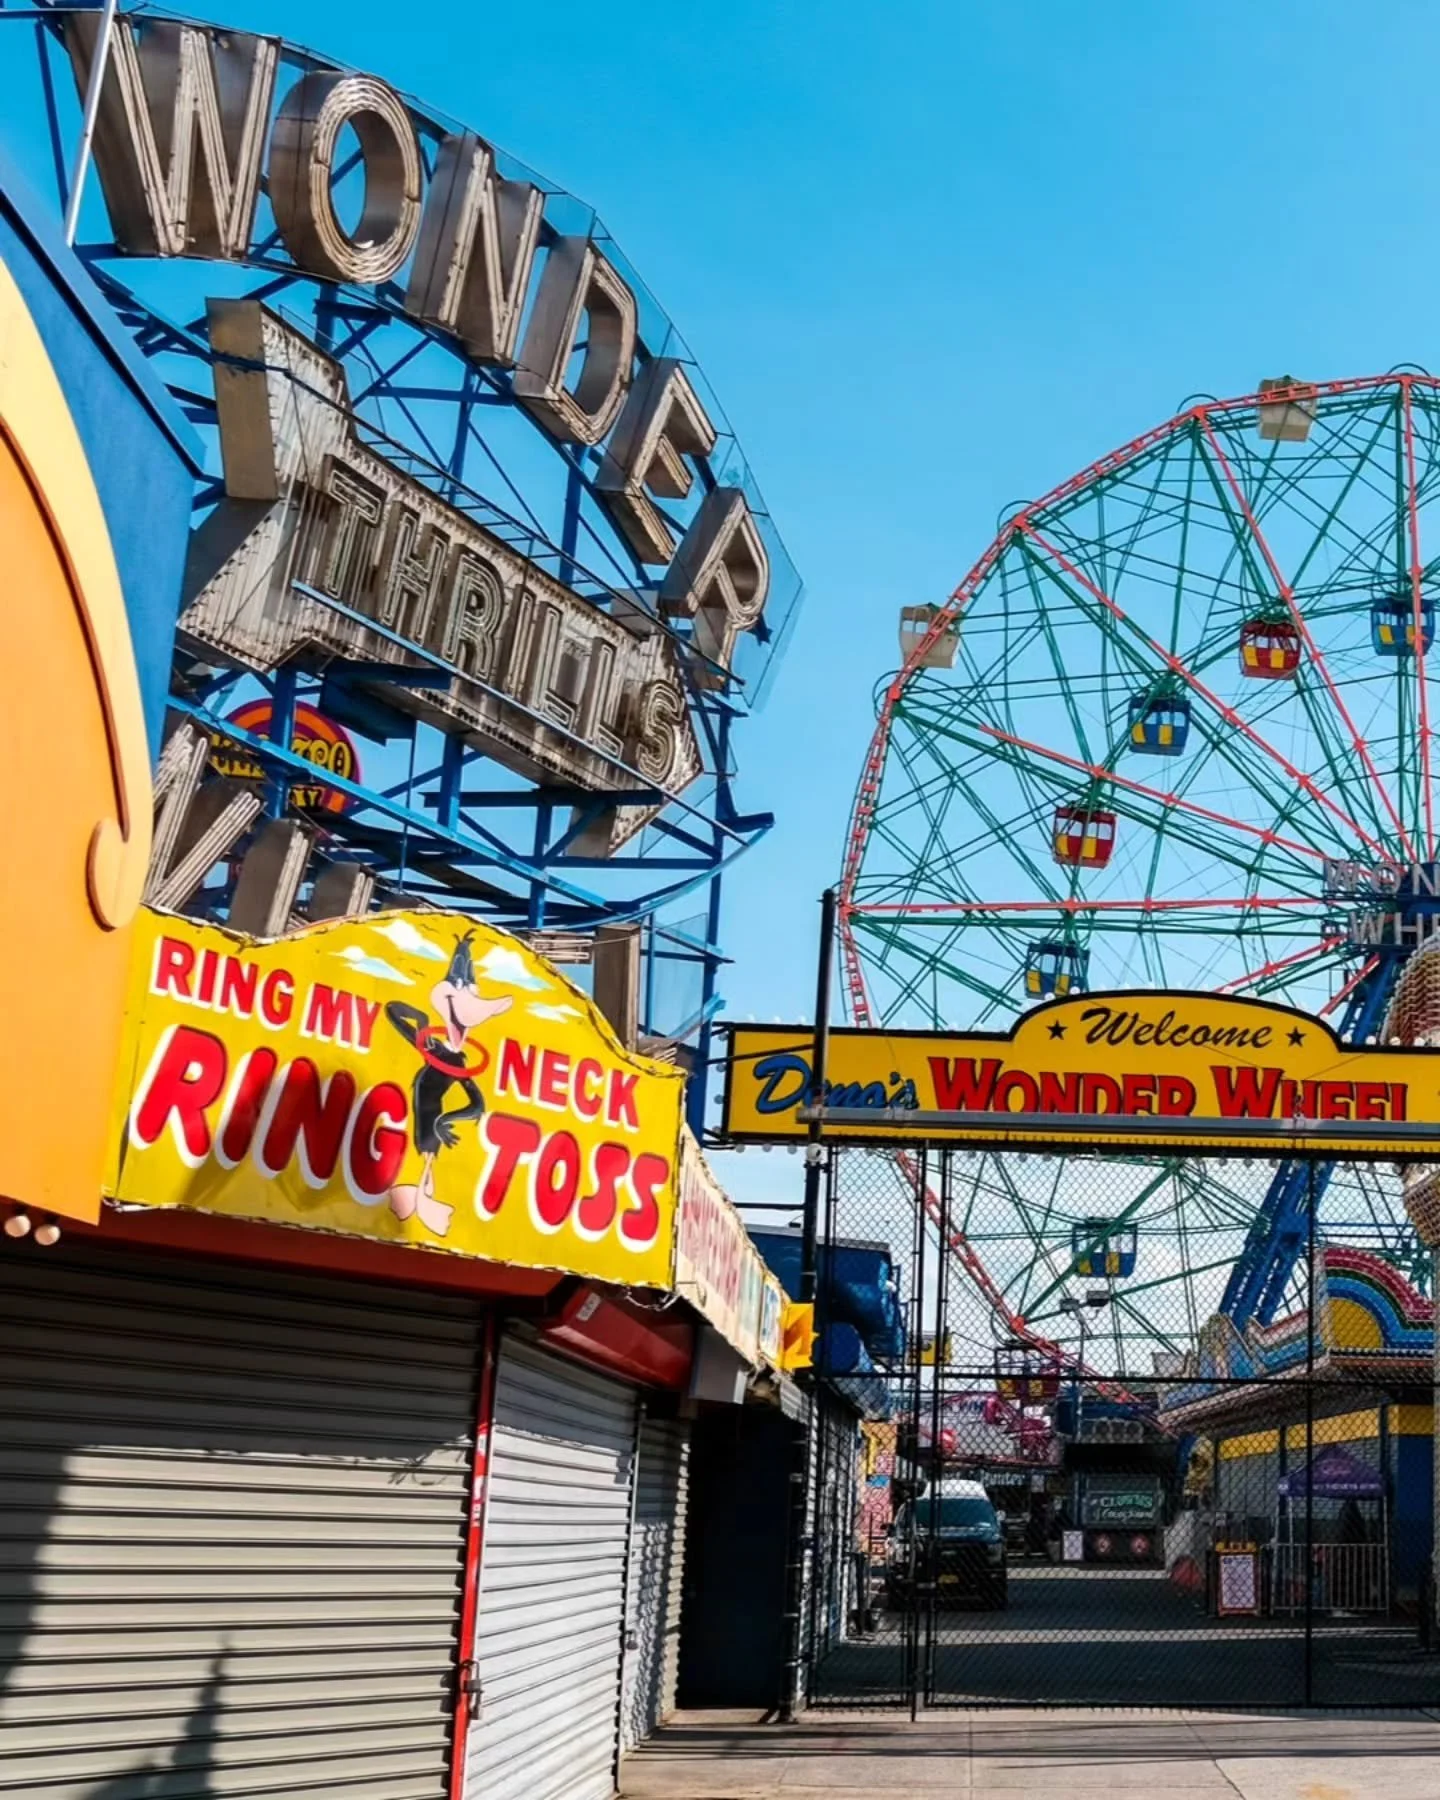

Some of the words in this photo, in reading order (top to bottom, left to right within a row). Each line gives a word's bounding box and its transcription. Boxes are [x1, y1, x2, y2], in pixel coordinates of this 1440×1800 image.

[88, 12, 770, 690] WONDER
[318, 455, 688, 785] THRILLS
[1080, 1006, 1274, 1049] Welcome
[1348, 911, 1440, 946] WH
[149, 935, 295, 1031] RING
[299, 982, 382, 1054] MY
[494, 1037, 640, 1133] NECK
[752, 1054, 920, 1114] Dno's
[927, 1056, 1197, 1117] WONDER
[129, 1024, 409, 1206] RING
[474, 1111, 670, 1254] TOSS
